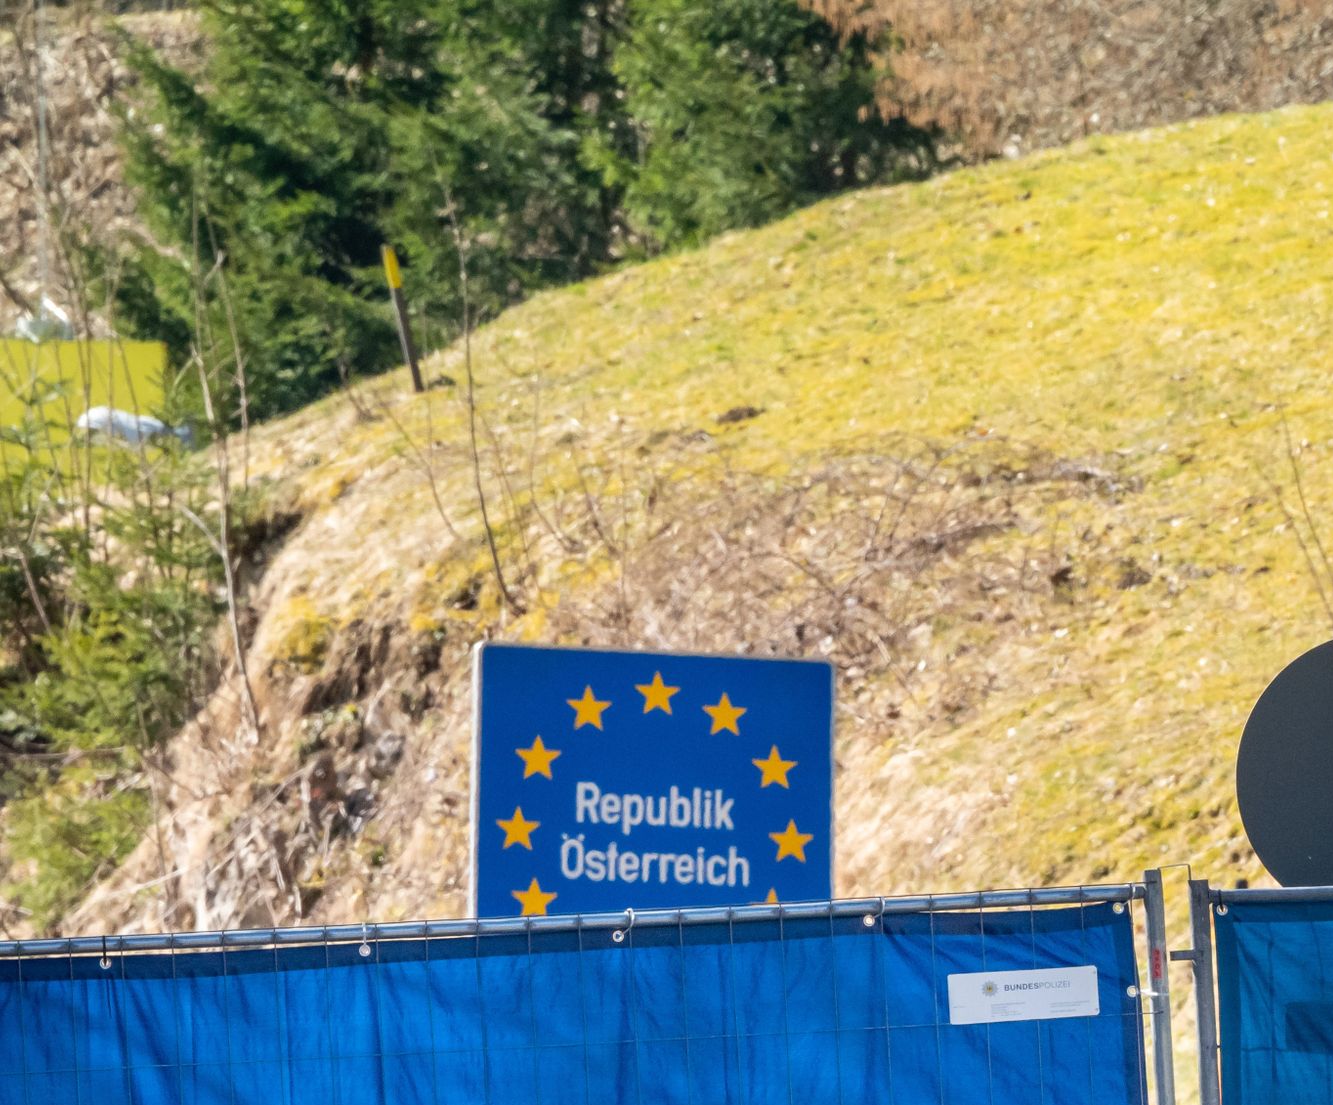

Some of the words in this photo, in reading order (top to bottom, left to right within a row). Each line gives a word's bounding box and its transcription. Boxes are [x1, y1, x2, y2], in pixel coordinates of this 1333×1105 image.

[575, 781, 735, 836] Republik
[561, 834, 750, 887] Österreich
[1004, 980, 1071, 992] BUNDESPOLIZEI
